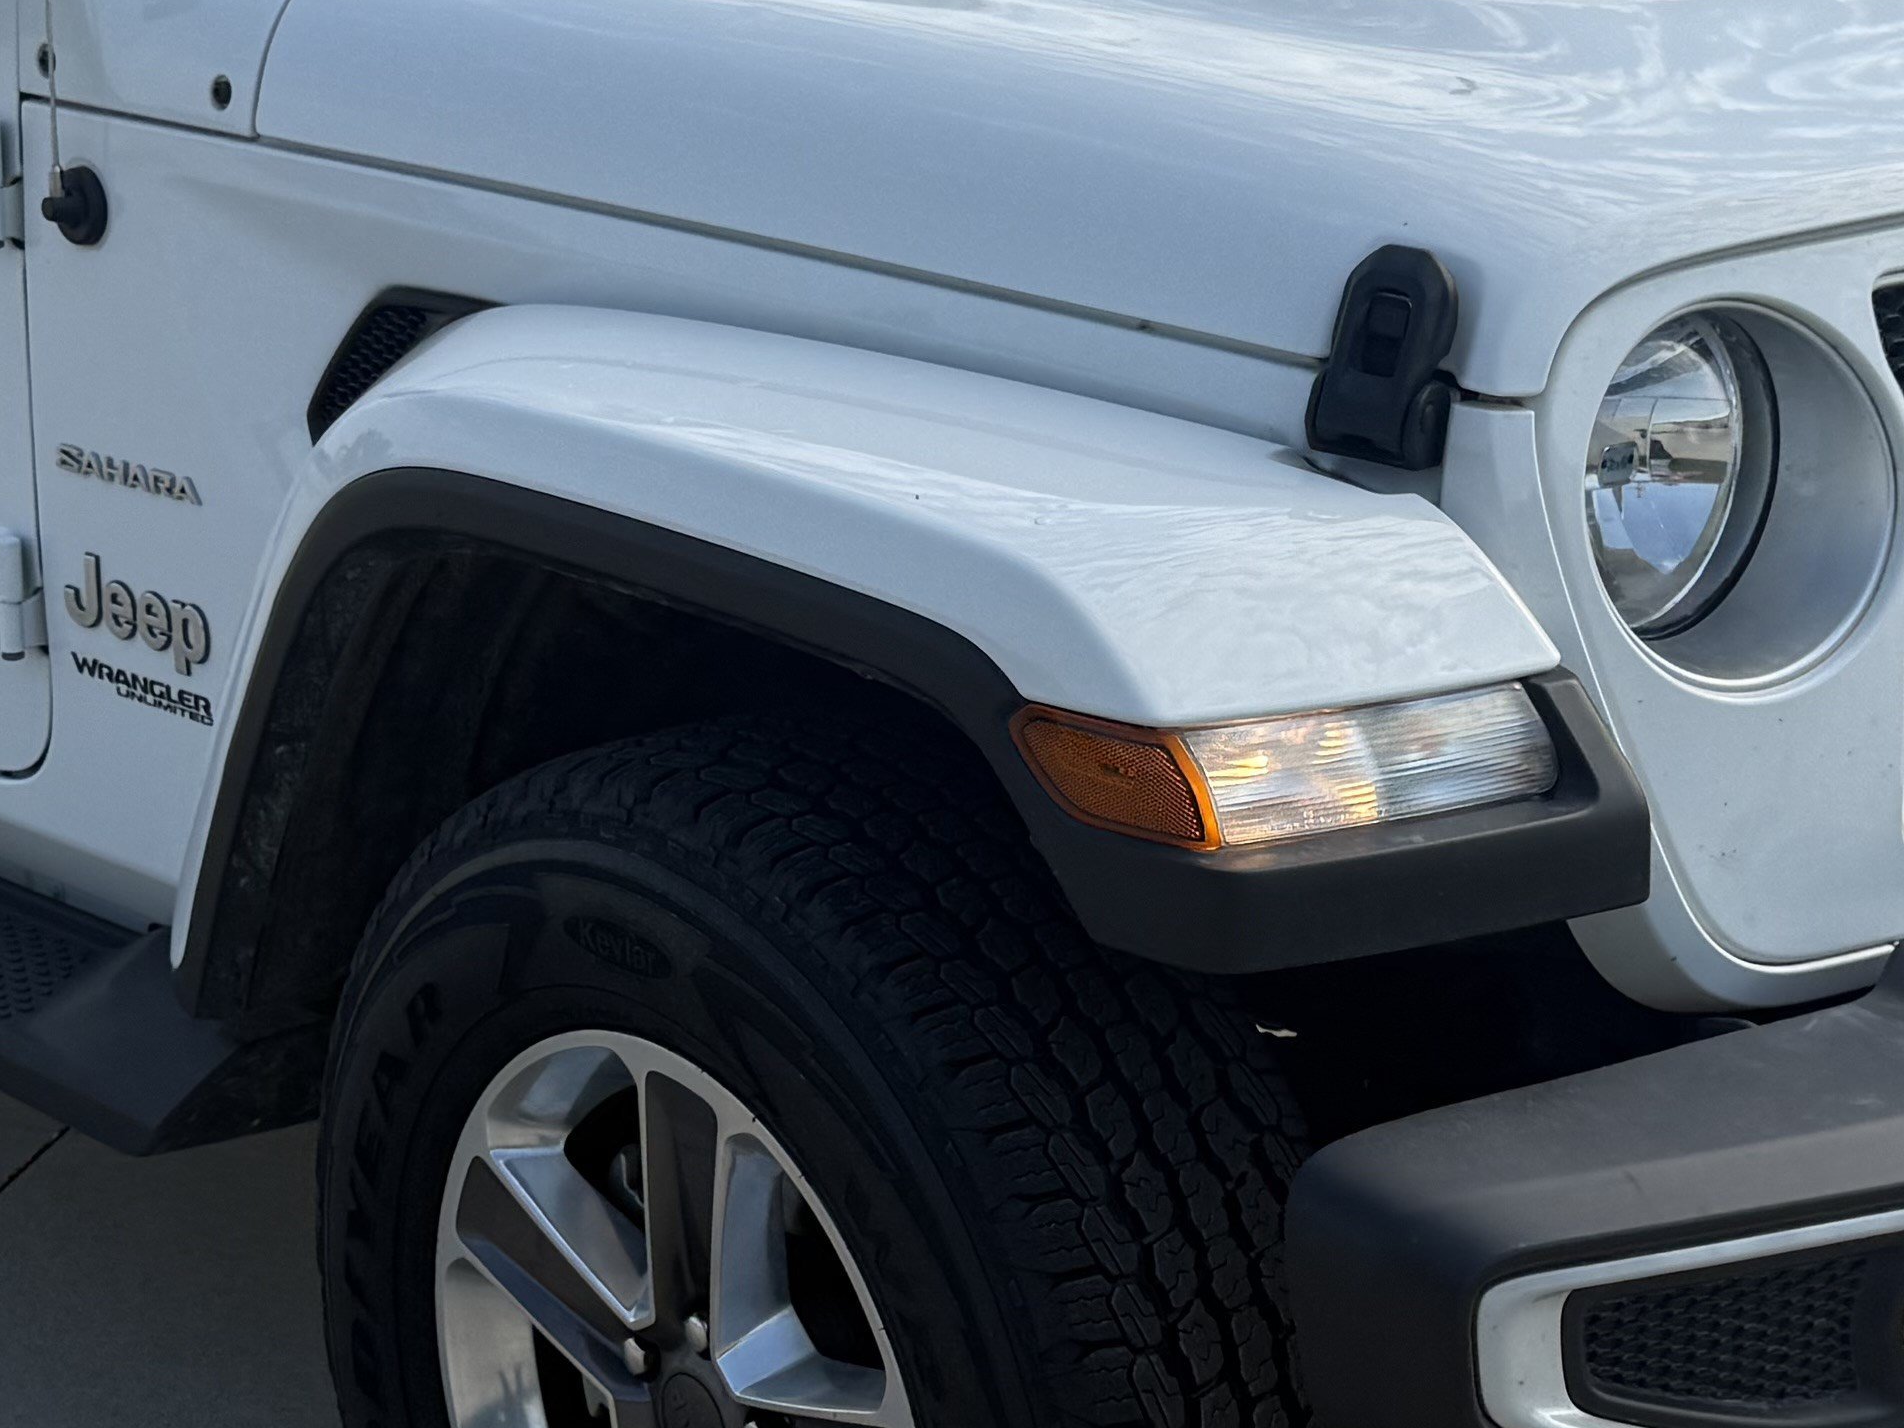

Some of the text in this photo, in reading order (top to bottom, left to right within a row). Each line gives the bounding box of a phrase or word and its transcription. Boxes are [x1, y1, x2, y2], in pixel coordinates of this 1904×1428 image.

[55, 442, 203, 506] SAHARA
[63, 551, 211, 677] Jeep
[70, 650, 214, 718] WRANGLER
[115, 685, 214, 727] UNLIMITED
[578, 917, 658, 976] Kevlar
